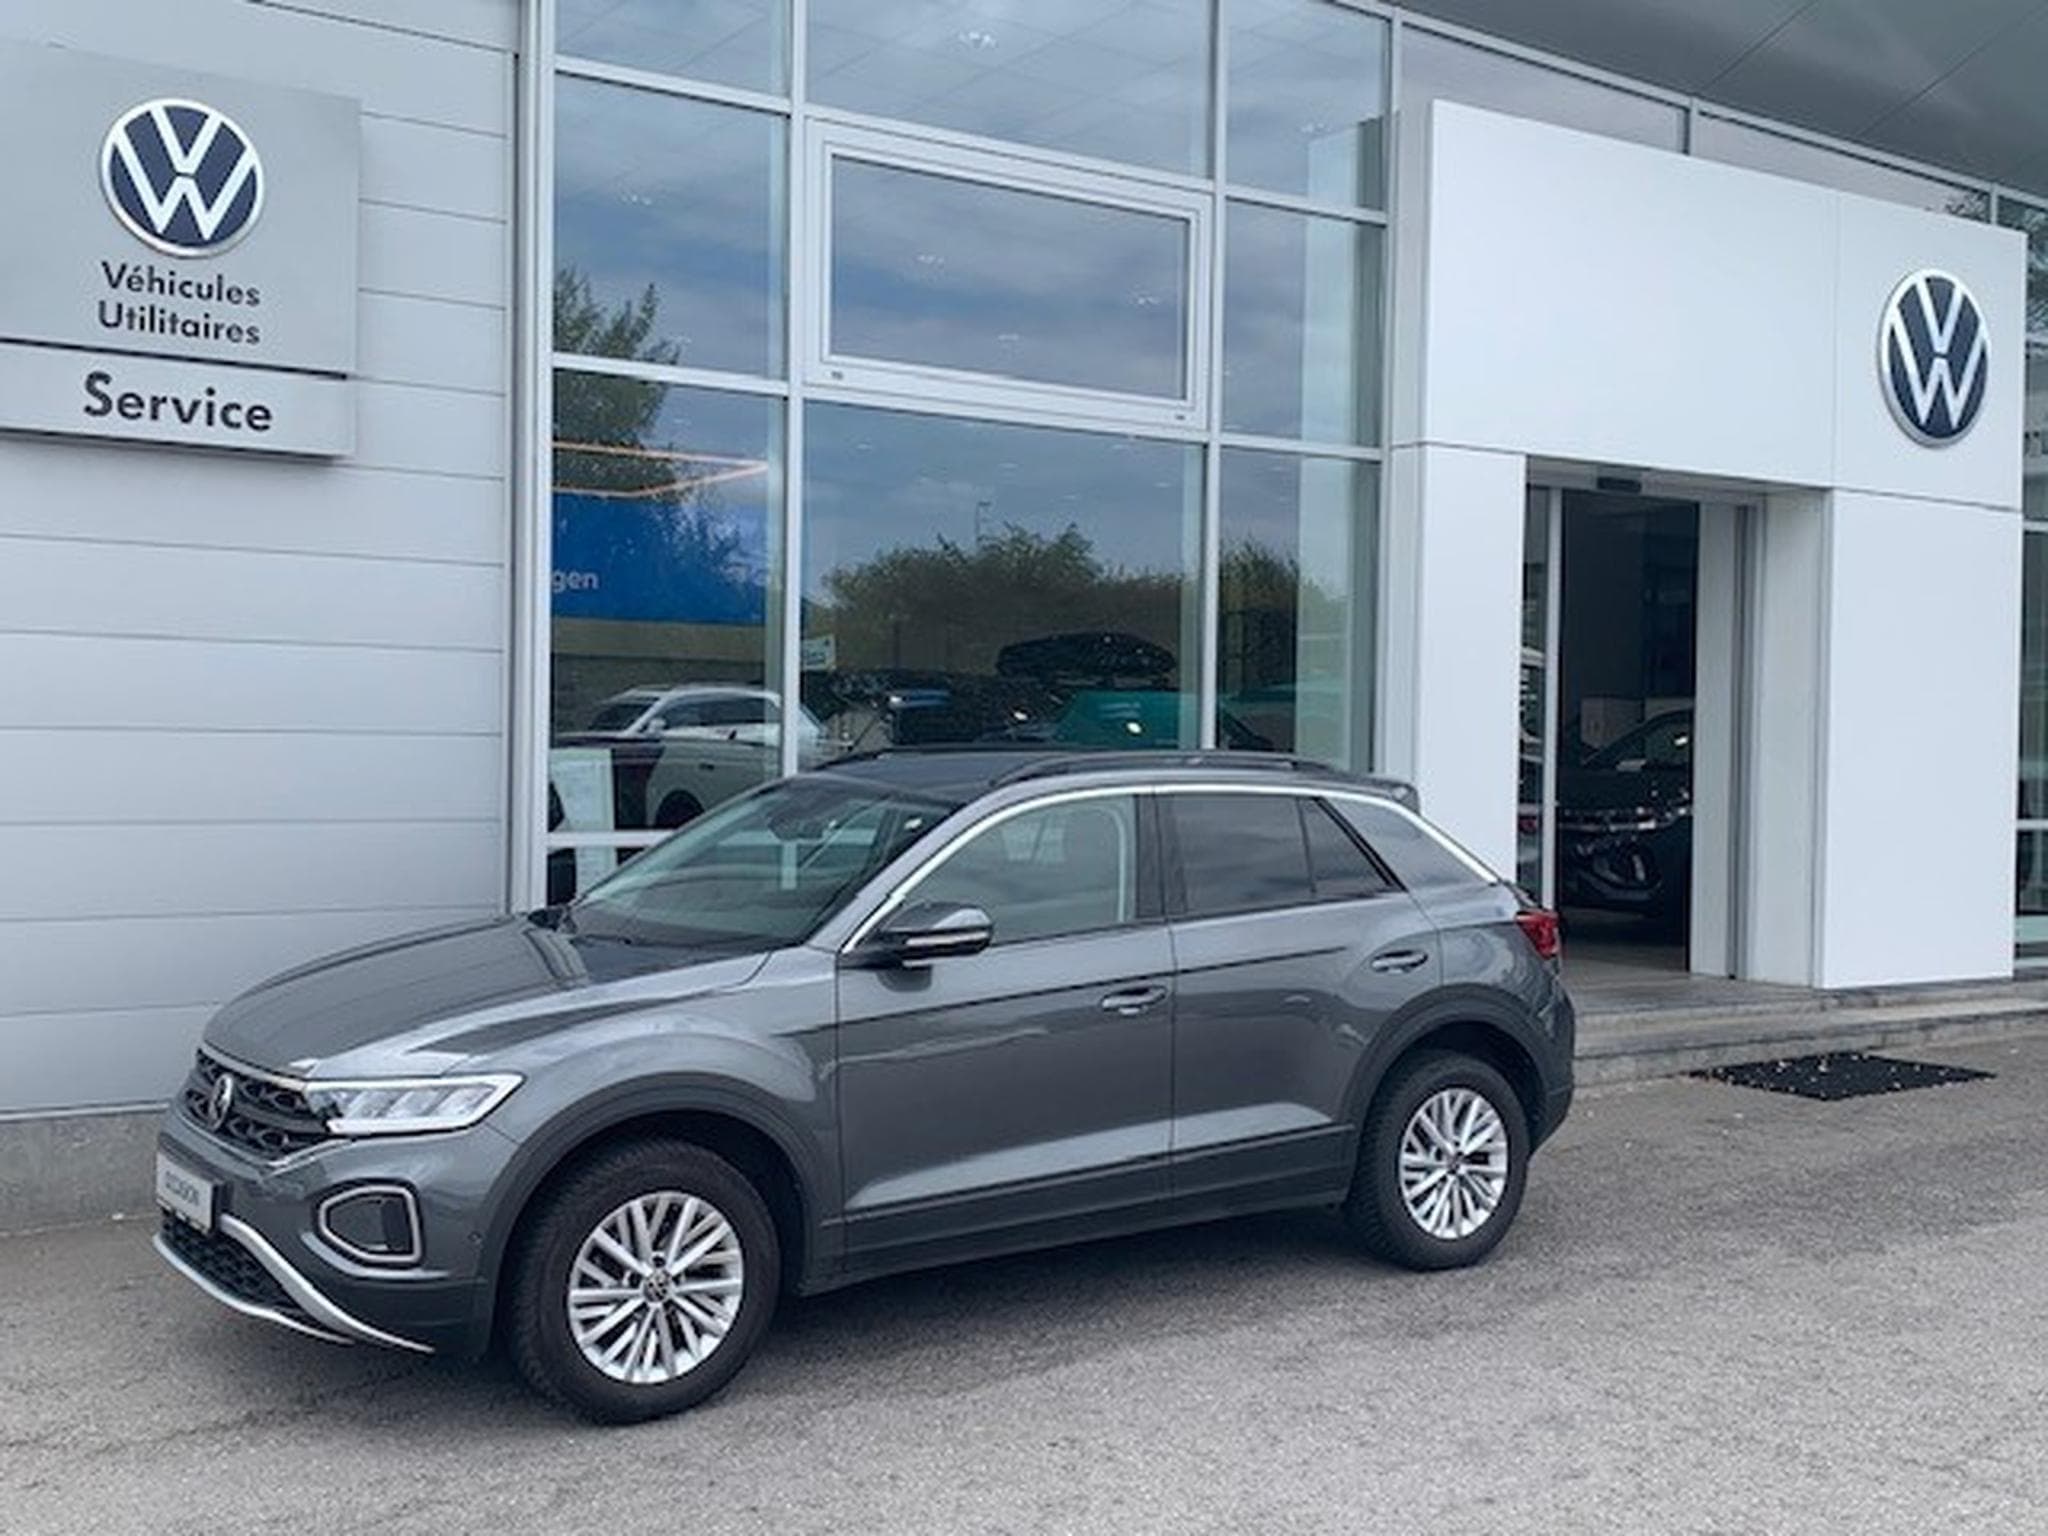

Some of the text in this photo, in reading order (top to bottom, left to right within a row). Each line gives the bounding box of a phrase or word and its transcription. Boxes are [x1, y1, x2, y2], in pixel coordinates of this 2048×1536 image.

[107, 101, 263, 246] VW
[101, 260, 260, 306] Véhicules
[98, 300, 261, 345] Utilitaires
[1884, 272, 1990, 436] VW
[83, 370, 273, 432] Service
